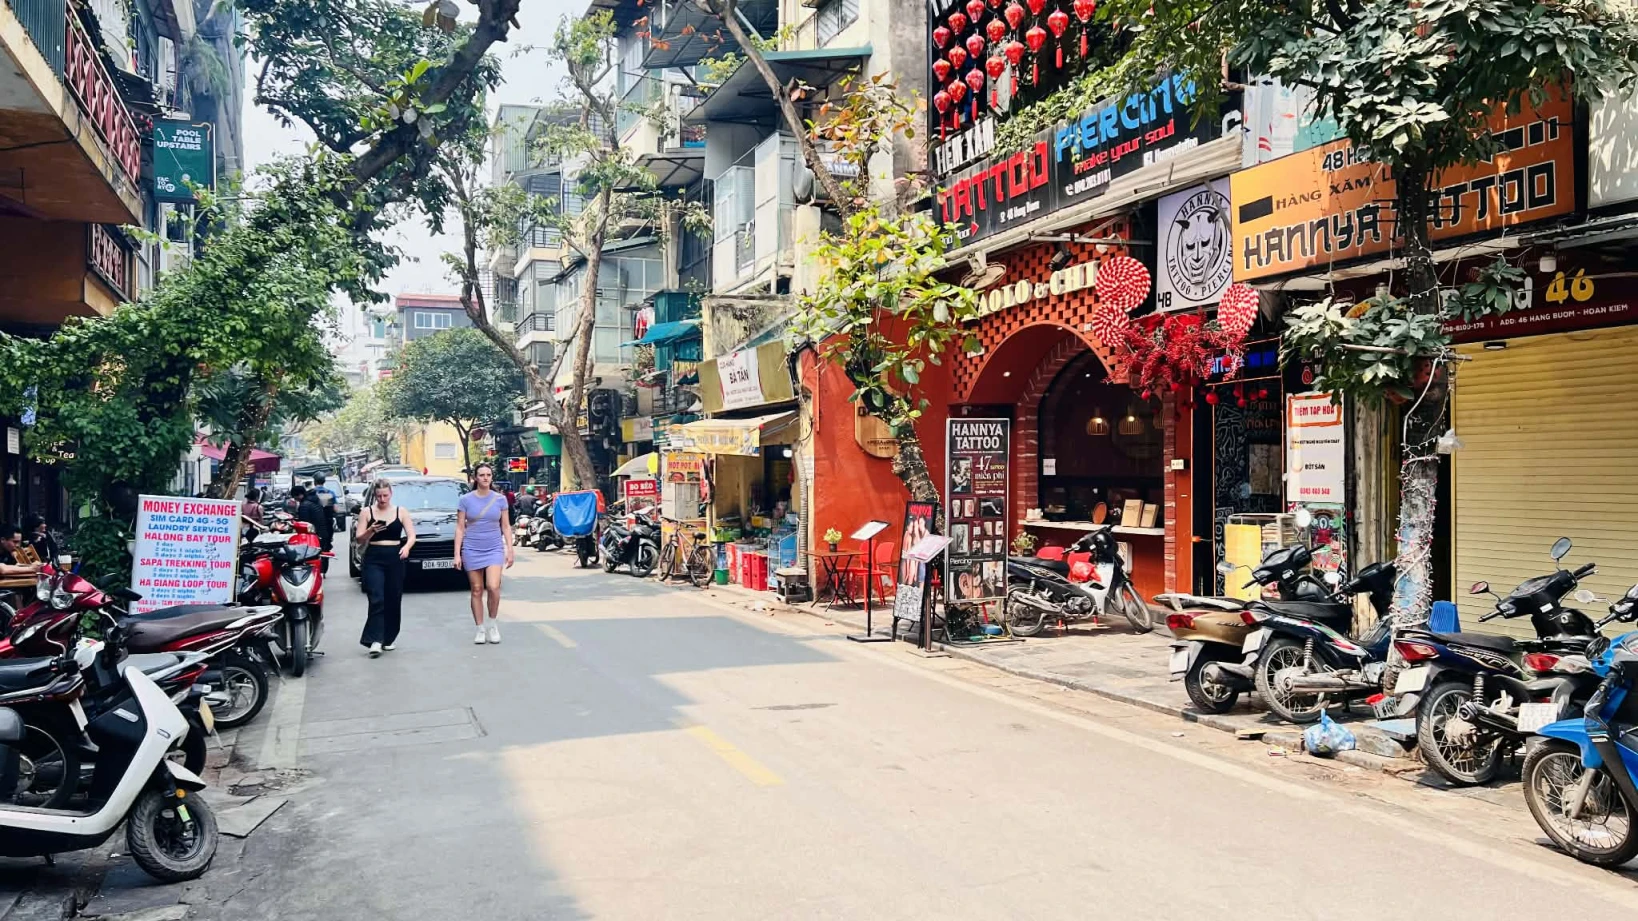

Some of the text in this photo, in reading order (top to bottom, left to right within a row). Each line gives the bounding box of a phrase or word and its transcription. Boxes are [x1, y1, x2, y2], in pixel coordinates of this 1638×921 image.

[157, 141, 201, 150] UPSTAIRS
[1110, 136, 1142, 163] your
[1145, 119, 1175, 146] soul
[1321, 150, 1344, 172] 48
[936, 140, 1050, 223] TATTOO
[1275, 189, 1322, 211] HÀNG
[1329, 175, 1371, 196] XĂM
[1243, 203, 1382, 270] HANNYA
[1545, 267, 1595, 304] 46
[976, 279, 1033, 319] AOLO
[1033, 282, 1050, 299] &
[1157, 291, 1172, 308] 48
[1583, 306, 1607, 316] HOAN
[951, 423, 1004, 436] HANNYA
[955, 436, 1000, 450] TATTOO
[58, 450, 75, 459] Tea
[975, 455, 992, 471] 47
[143, 500, 237, 517] MONEY EXCHANGE
[150, 514, 166, 522] SIM
[168, 515, 194, 523] CARD
[196, 516, 209, 525] 4G
[216, 517, 229, 525] 5G
[148, 523, 229, 534] LAUNDRY SERVICE
[144, 532, 231, 543] HALONG BAY TOUR
[140, 558, 231, 568] SAPA TREKKING TOUR
[139, 578, 228, 589] HA GIANG LOOP TOUR
